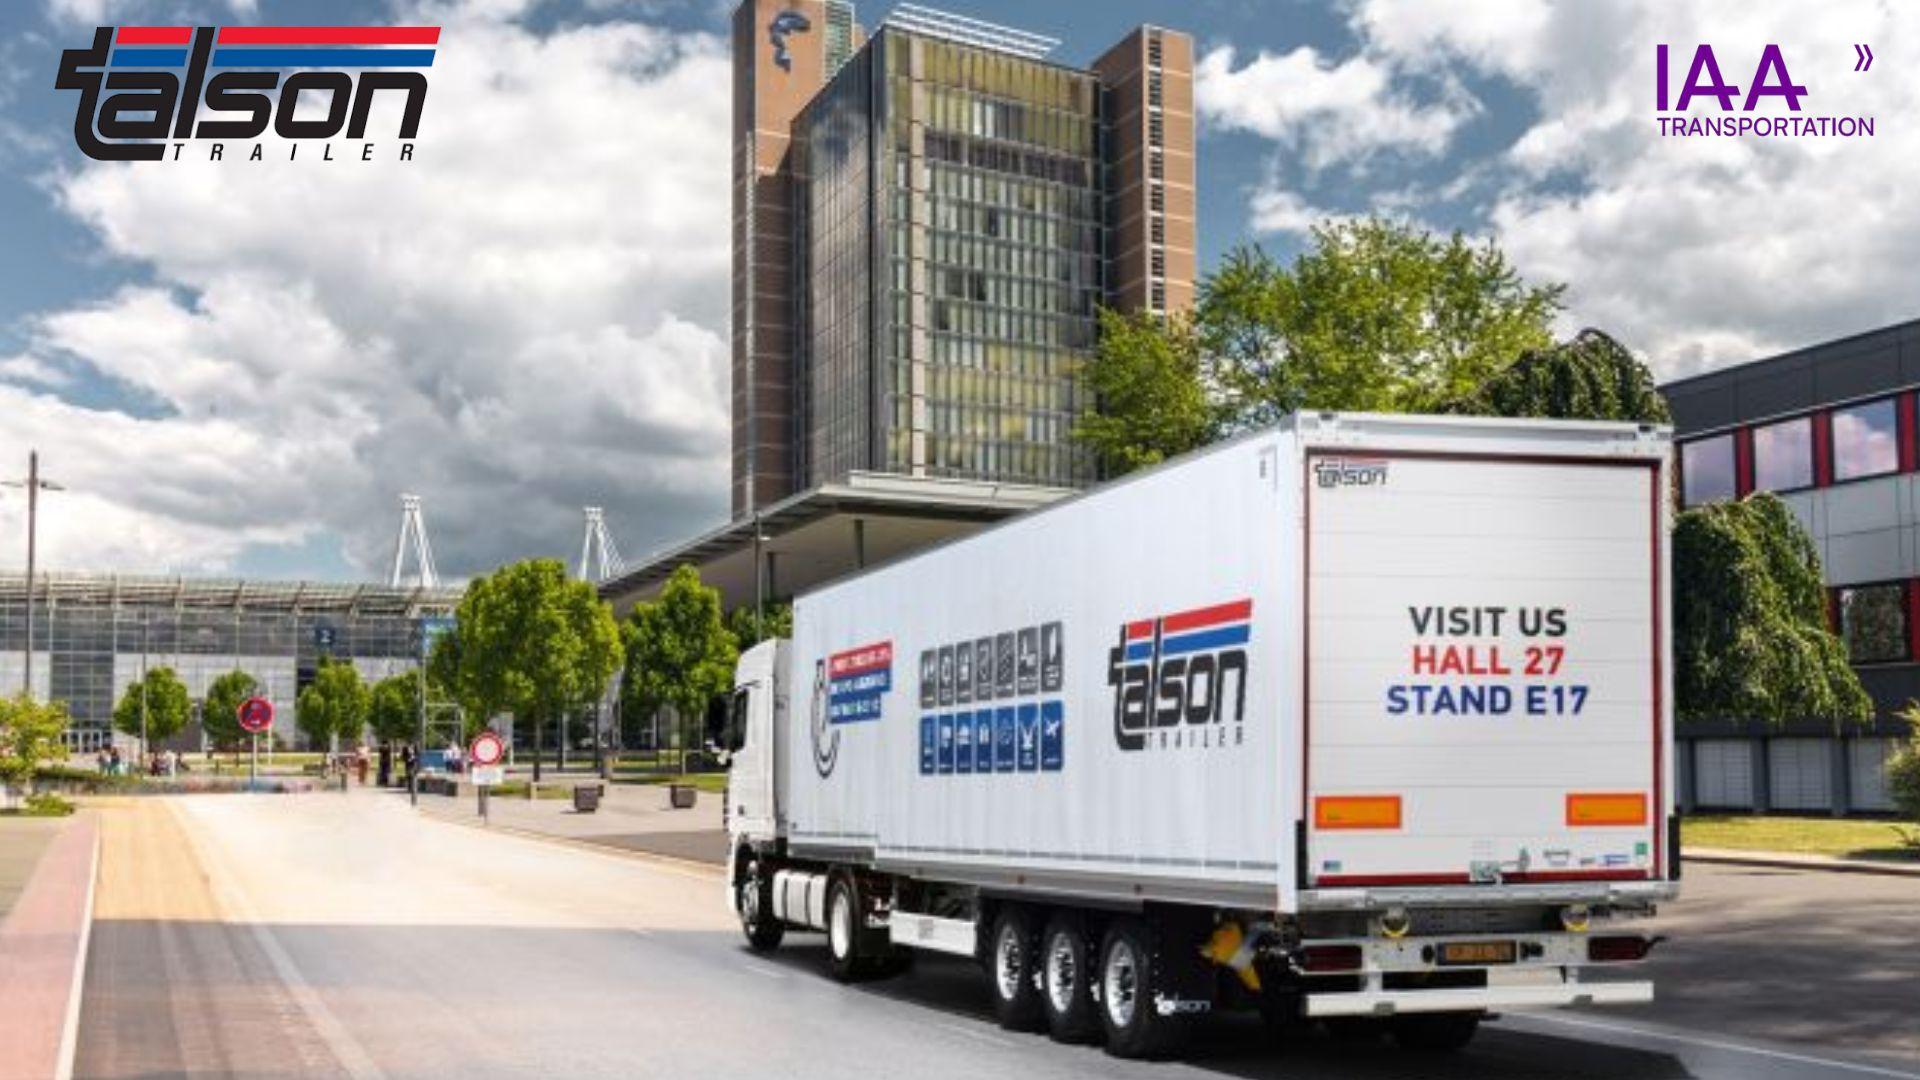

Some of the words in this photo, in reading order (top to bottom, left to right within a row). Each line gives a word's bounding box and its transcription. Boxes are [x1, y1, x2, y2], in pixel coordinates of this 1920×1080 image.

[1315, 458, 1388, 487] talson
[1408, 606, 1506, 637] VISIT
[1519, 606, 1568, 637] US
[1413, 645, 1511, 675] HALL
[1524, 646, 1565, 675] 27
[1108, 616, 1247, 751] talson
[1386, 685, 1512, 715] STAND
[1526, 685, 1589, 715] E17
